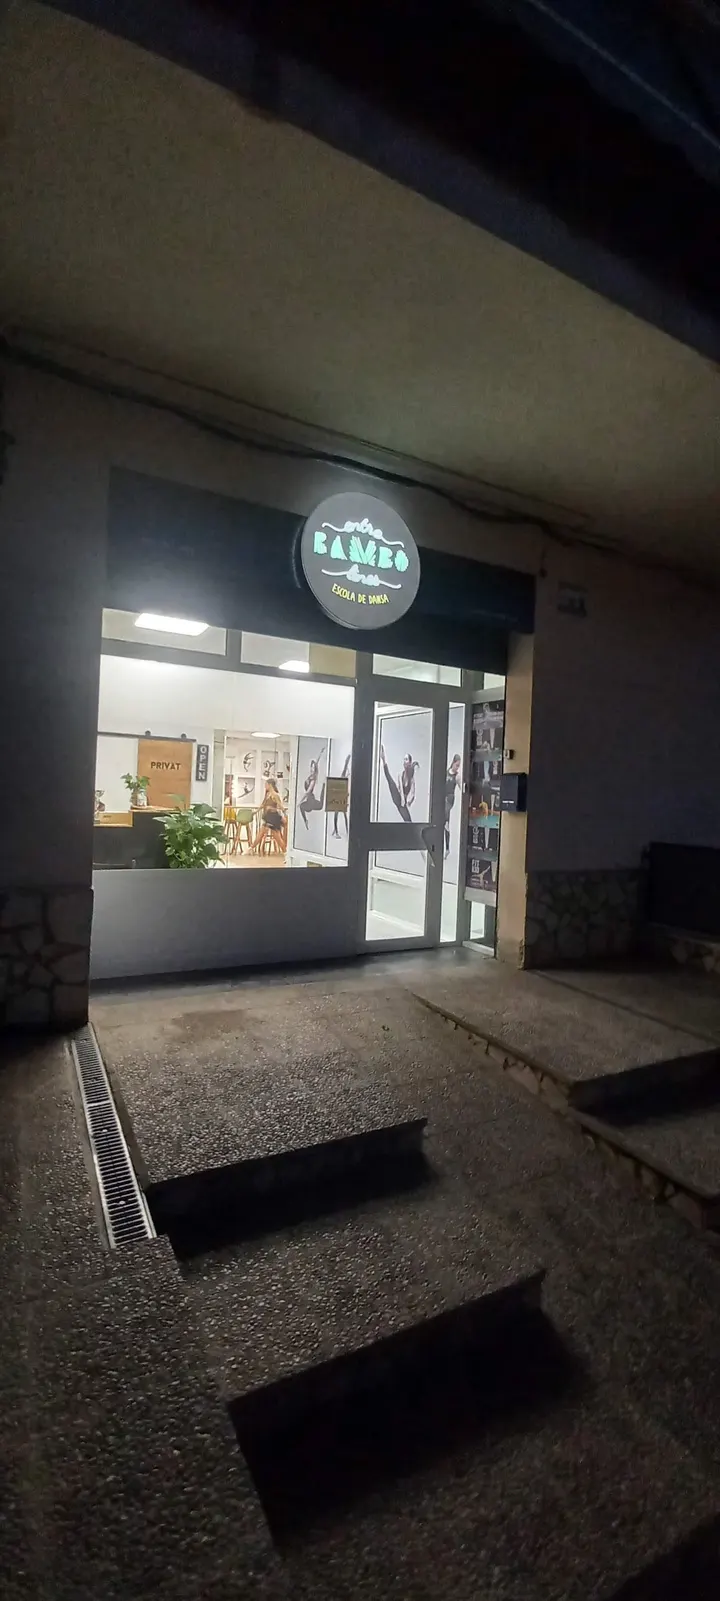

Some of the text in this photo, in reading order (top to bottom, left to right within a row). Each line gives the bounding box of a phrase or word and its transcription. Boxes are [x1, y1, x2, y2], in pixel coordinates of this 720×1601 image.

[331, 583, 390, 605] ESCOLA DE DANSA
[150, 761, 181, 771] PRIVAT
[198, 746, 207, 780] OPEN
